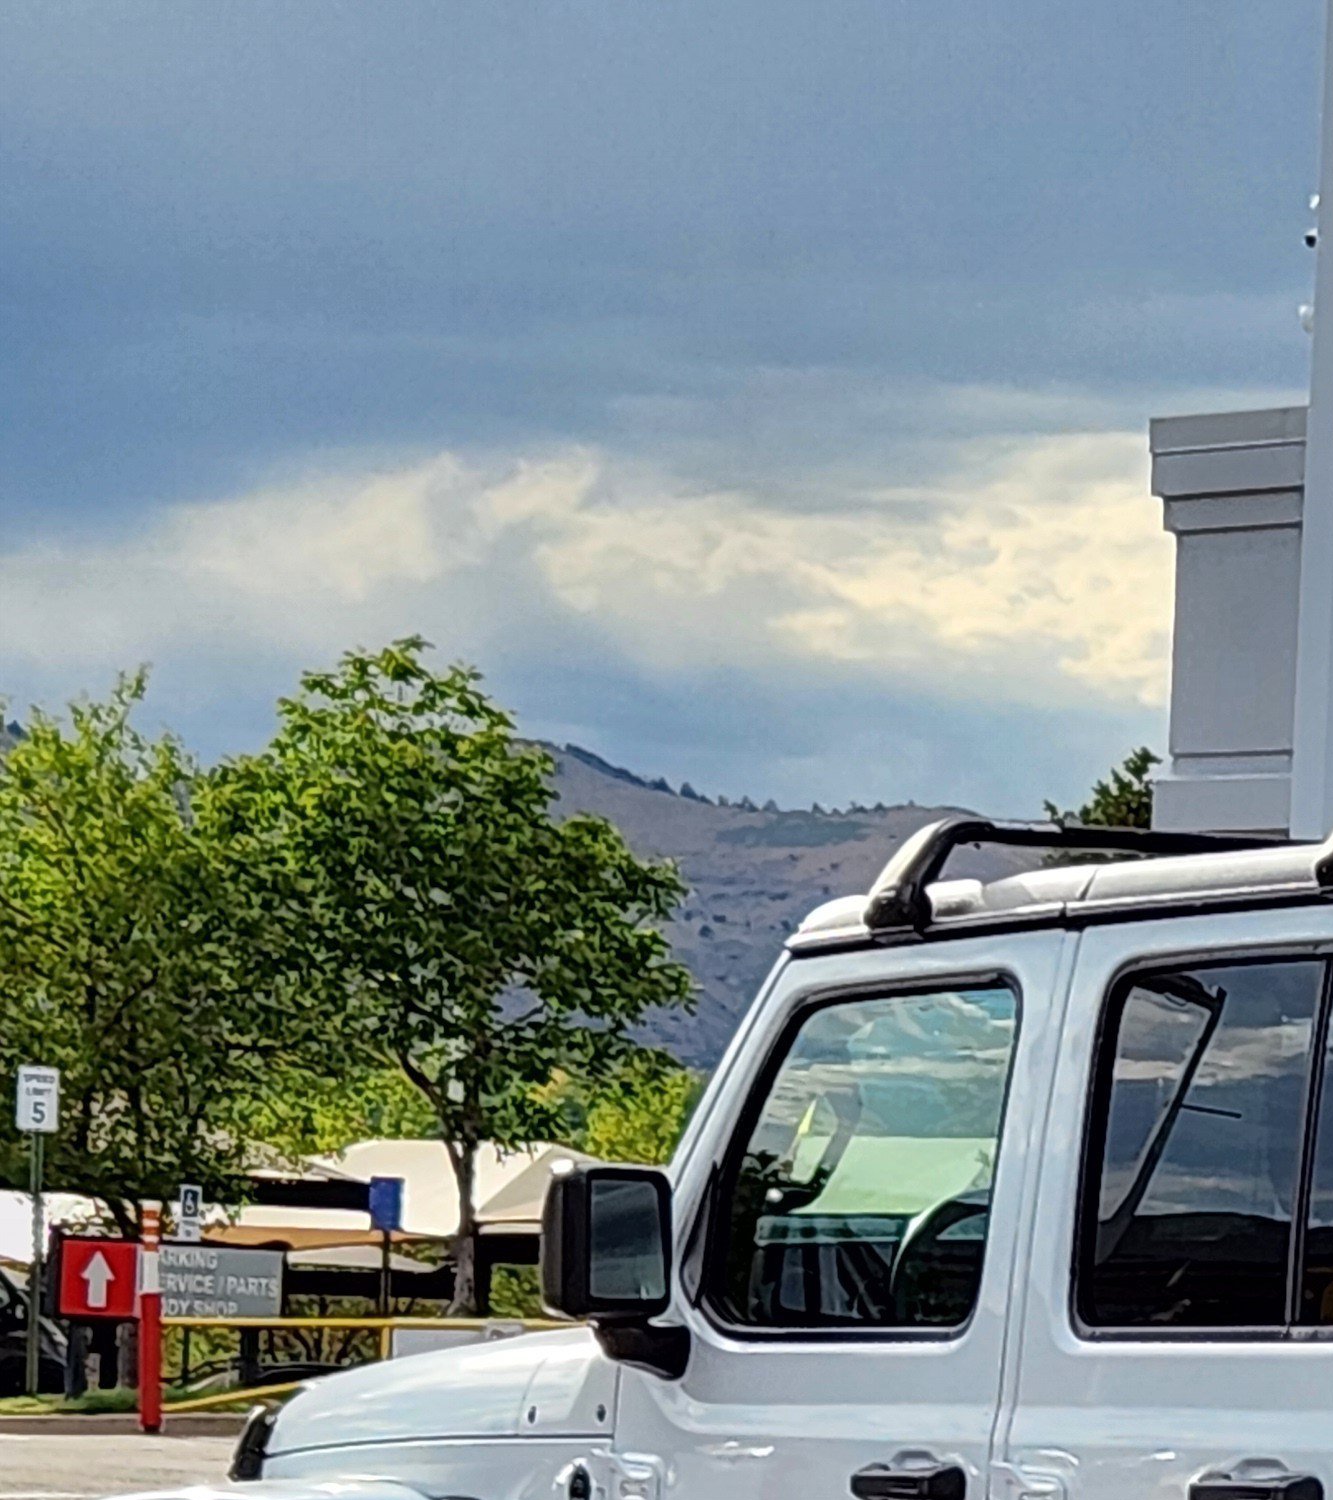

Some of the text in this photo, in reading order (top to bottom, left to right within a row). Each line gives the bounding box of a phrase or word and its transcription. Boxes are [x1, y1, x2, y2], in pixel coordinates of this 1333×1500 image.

[31, 1101, 46, 1124] 5
[160, 1250, 218, 1268] ARKING
[161, 1273, 214, 1295] ERVICE
[226, 1277, 278, 1298] PARTS
[193, 1301, 238, 1315] SHOP
